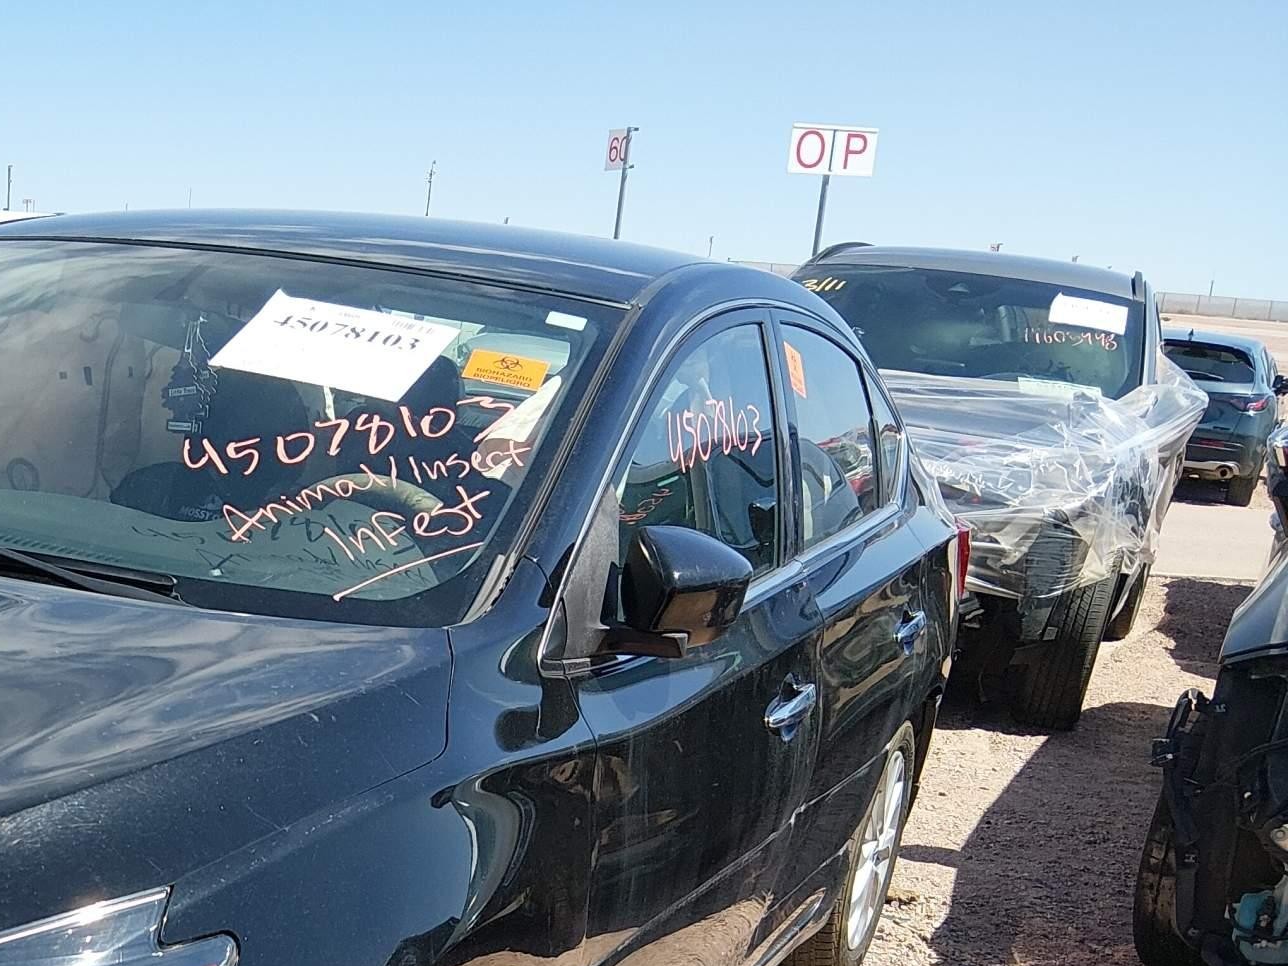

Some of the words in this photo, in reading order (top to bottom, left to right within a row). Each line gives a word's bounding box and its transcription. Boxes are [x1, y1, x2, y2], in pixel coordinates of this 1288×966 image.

[796, 130, 825, 168] O
[843, 133, 868, 169] P
[273, 315, 420, 350] 45078103
[184, 396, 515, 475] 45078103
[668, 396, 762, 473] 45078103
